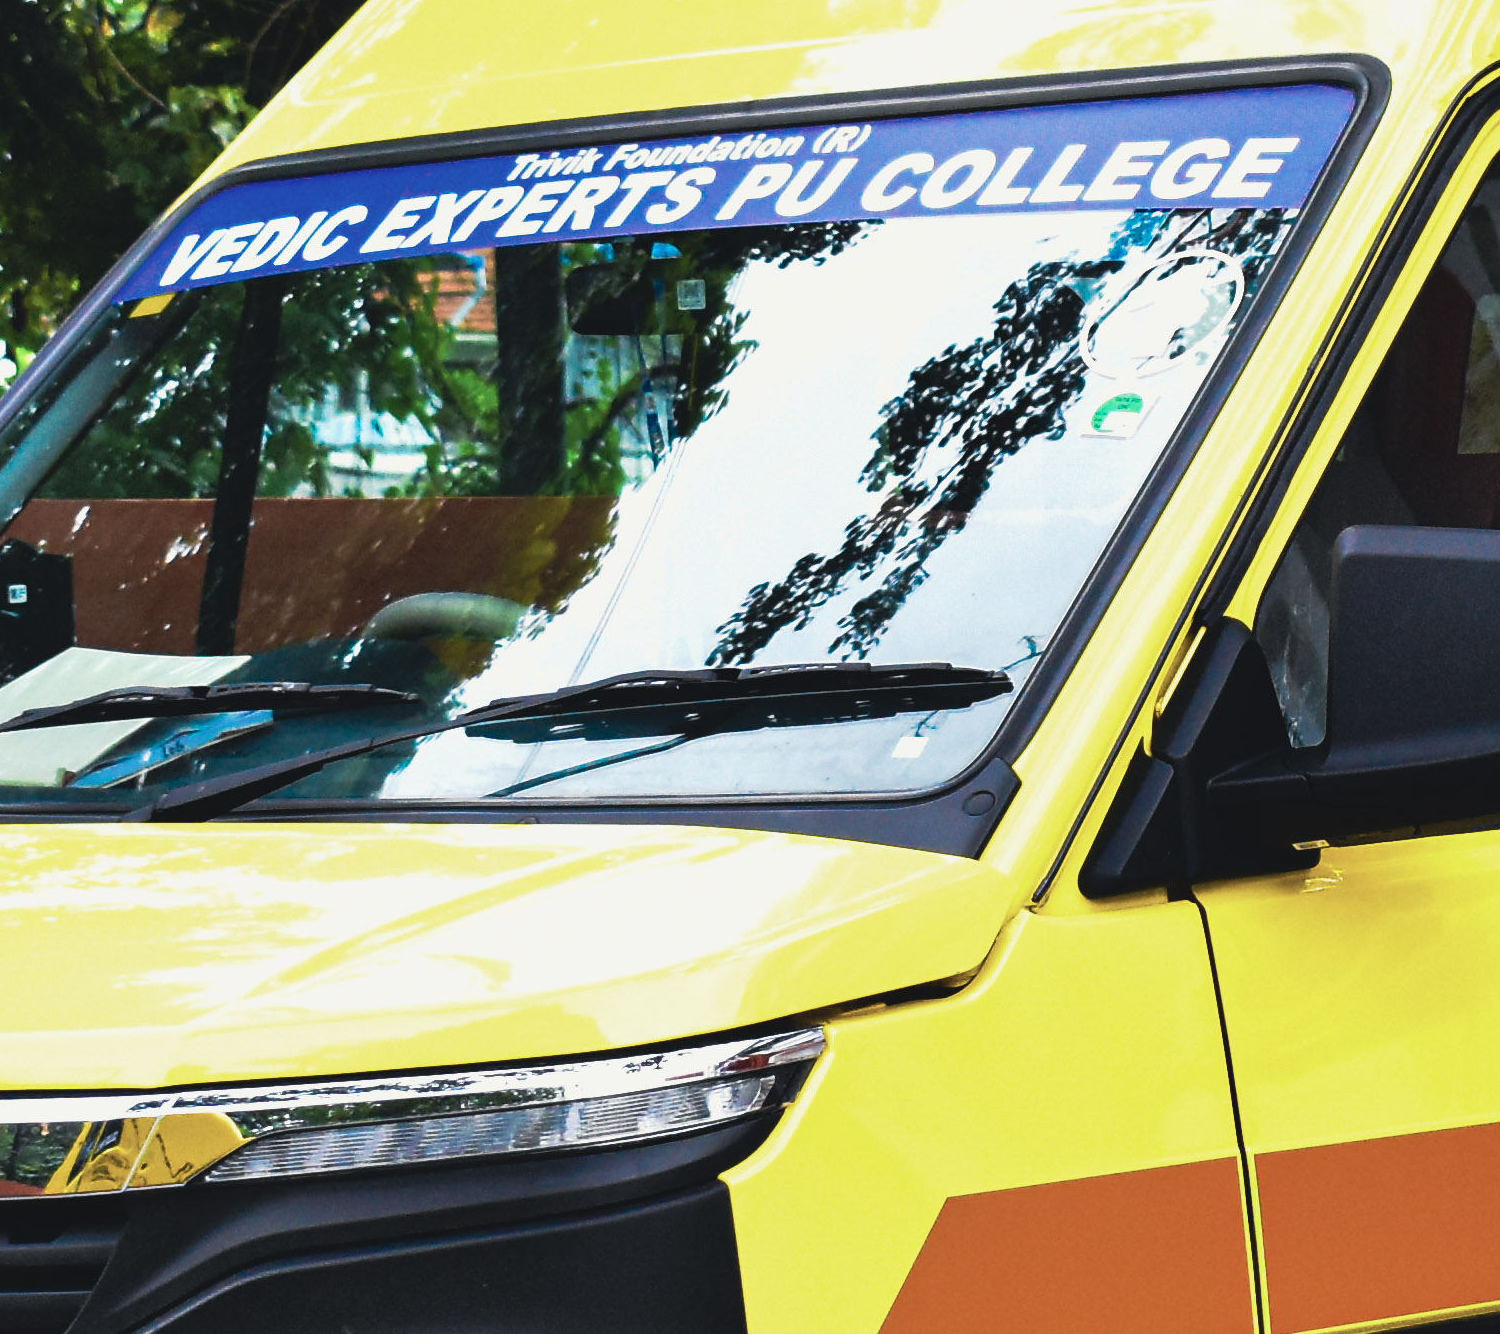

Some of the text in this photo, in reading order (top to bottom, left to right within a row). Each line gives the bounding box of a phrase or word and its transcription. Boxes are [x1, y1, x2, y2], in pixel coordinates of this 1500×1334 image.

[506, 124, 873, 181] Trivik Foundation (R)
[159, 137, 1301, 287] VEDIC EXPERTS PU COLLEGE
